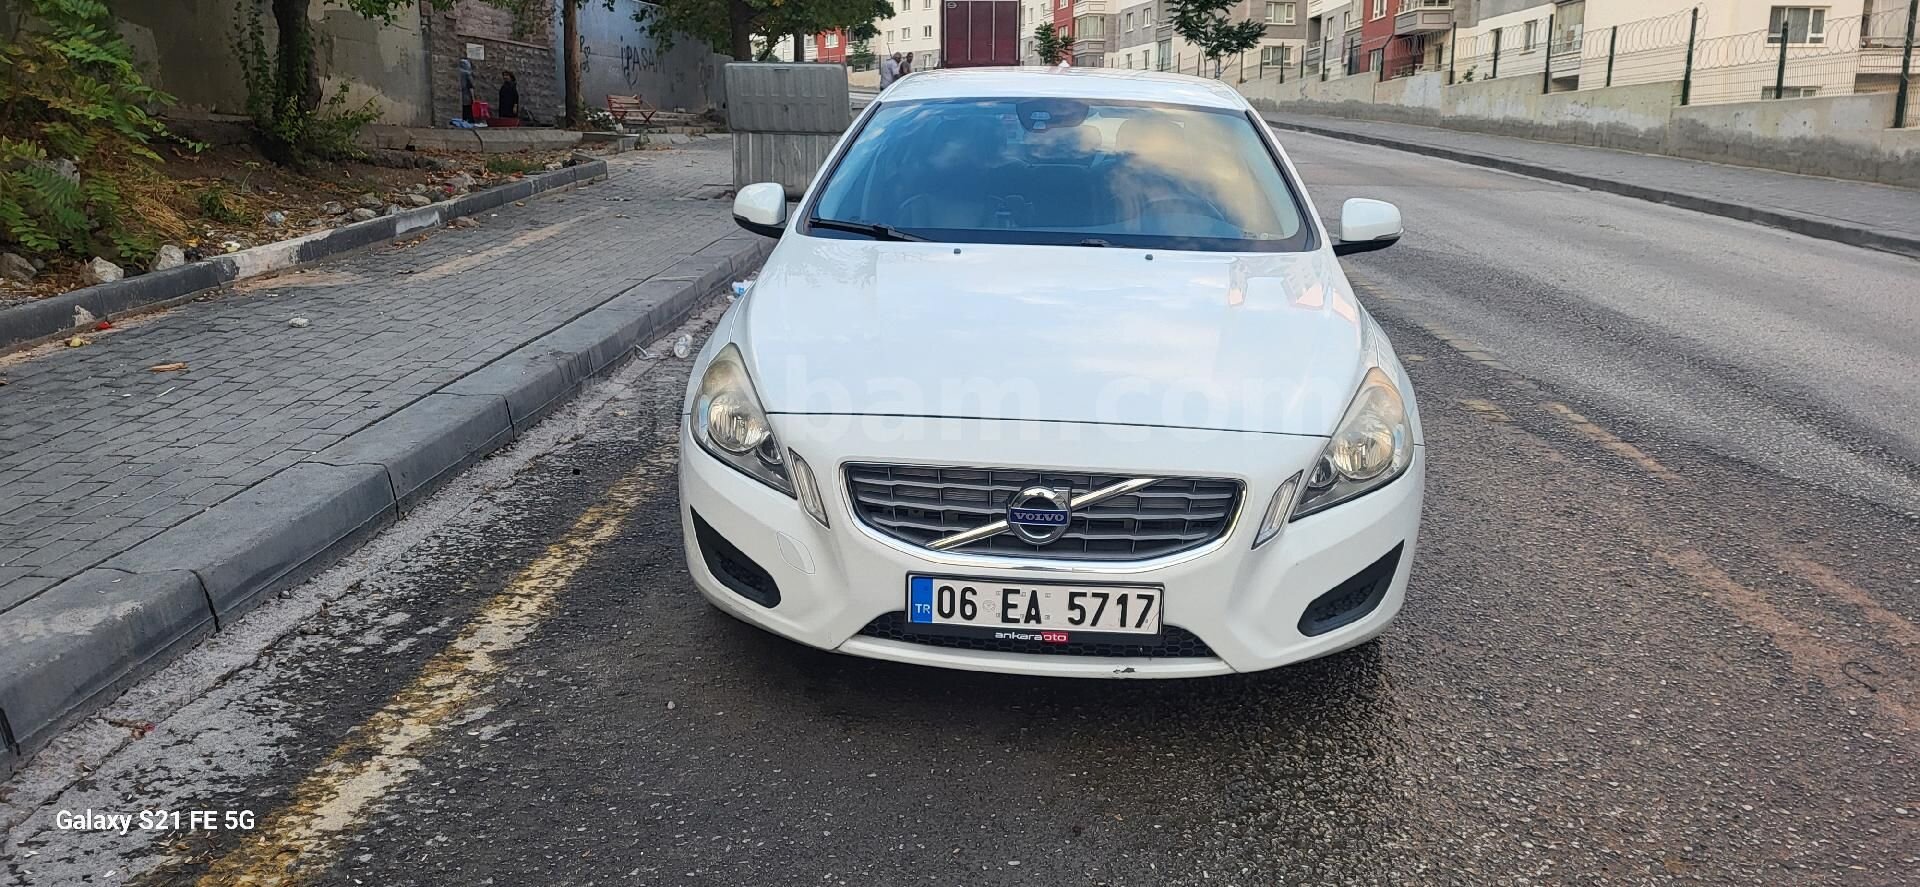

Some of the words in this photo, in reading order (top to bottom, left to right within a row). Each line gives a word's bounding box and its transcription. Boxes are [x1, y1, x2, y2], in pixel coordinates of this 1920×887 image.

[1013, 511, 1065, 523] VOLVO
[915, 603, 931, 614] TR
[937, 585, 978, 621] 06
[1001, 588, 1042, 625] EA
[1067, 591, 1155, 629] 5717
